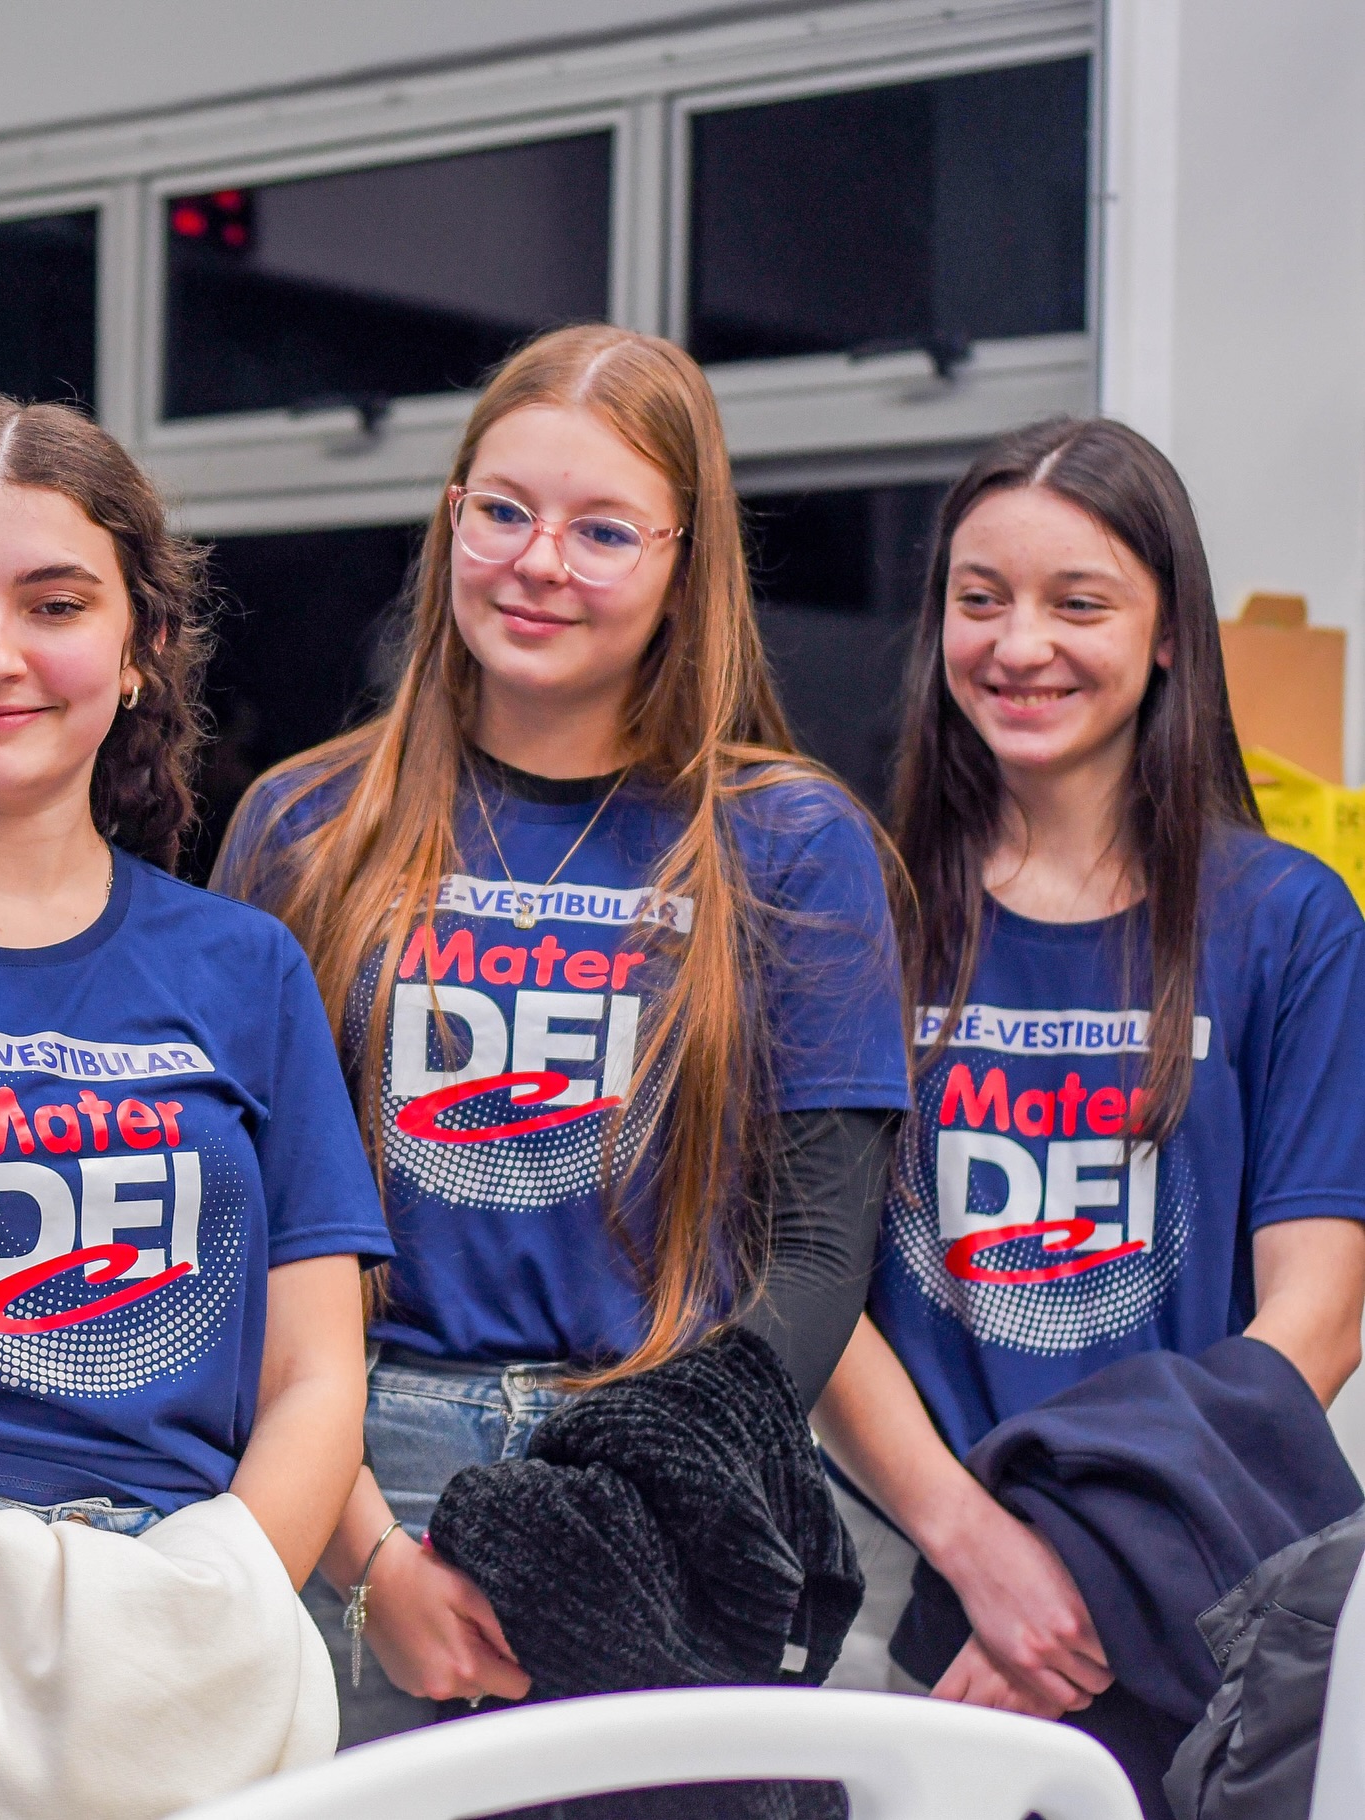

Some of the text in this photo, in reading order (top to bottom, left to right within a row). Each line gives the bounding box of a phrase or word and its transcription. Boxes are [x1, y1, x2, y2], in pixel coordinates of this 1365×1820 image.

[399, 926, 645, 990] Mater
[391, 983, 641, 1109] DEI
[937, 1130, 1158, 1254] DEI
